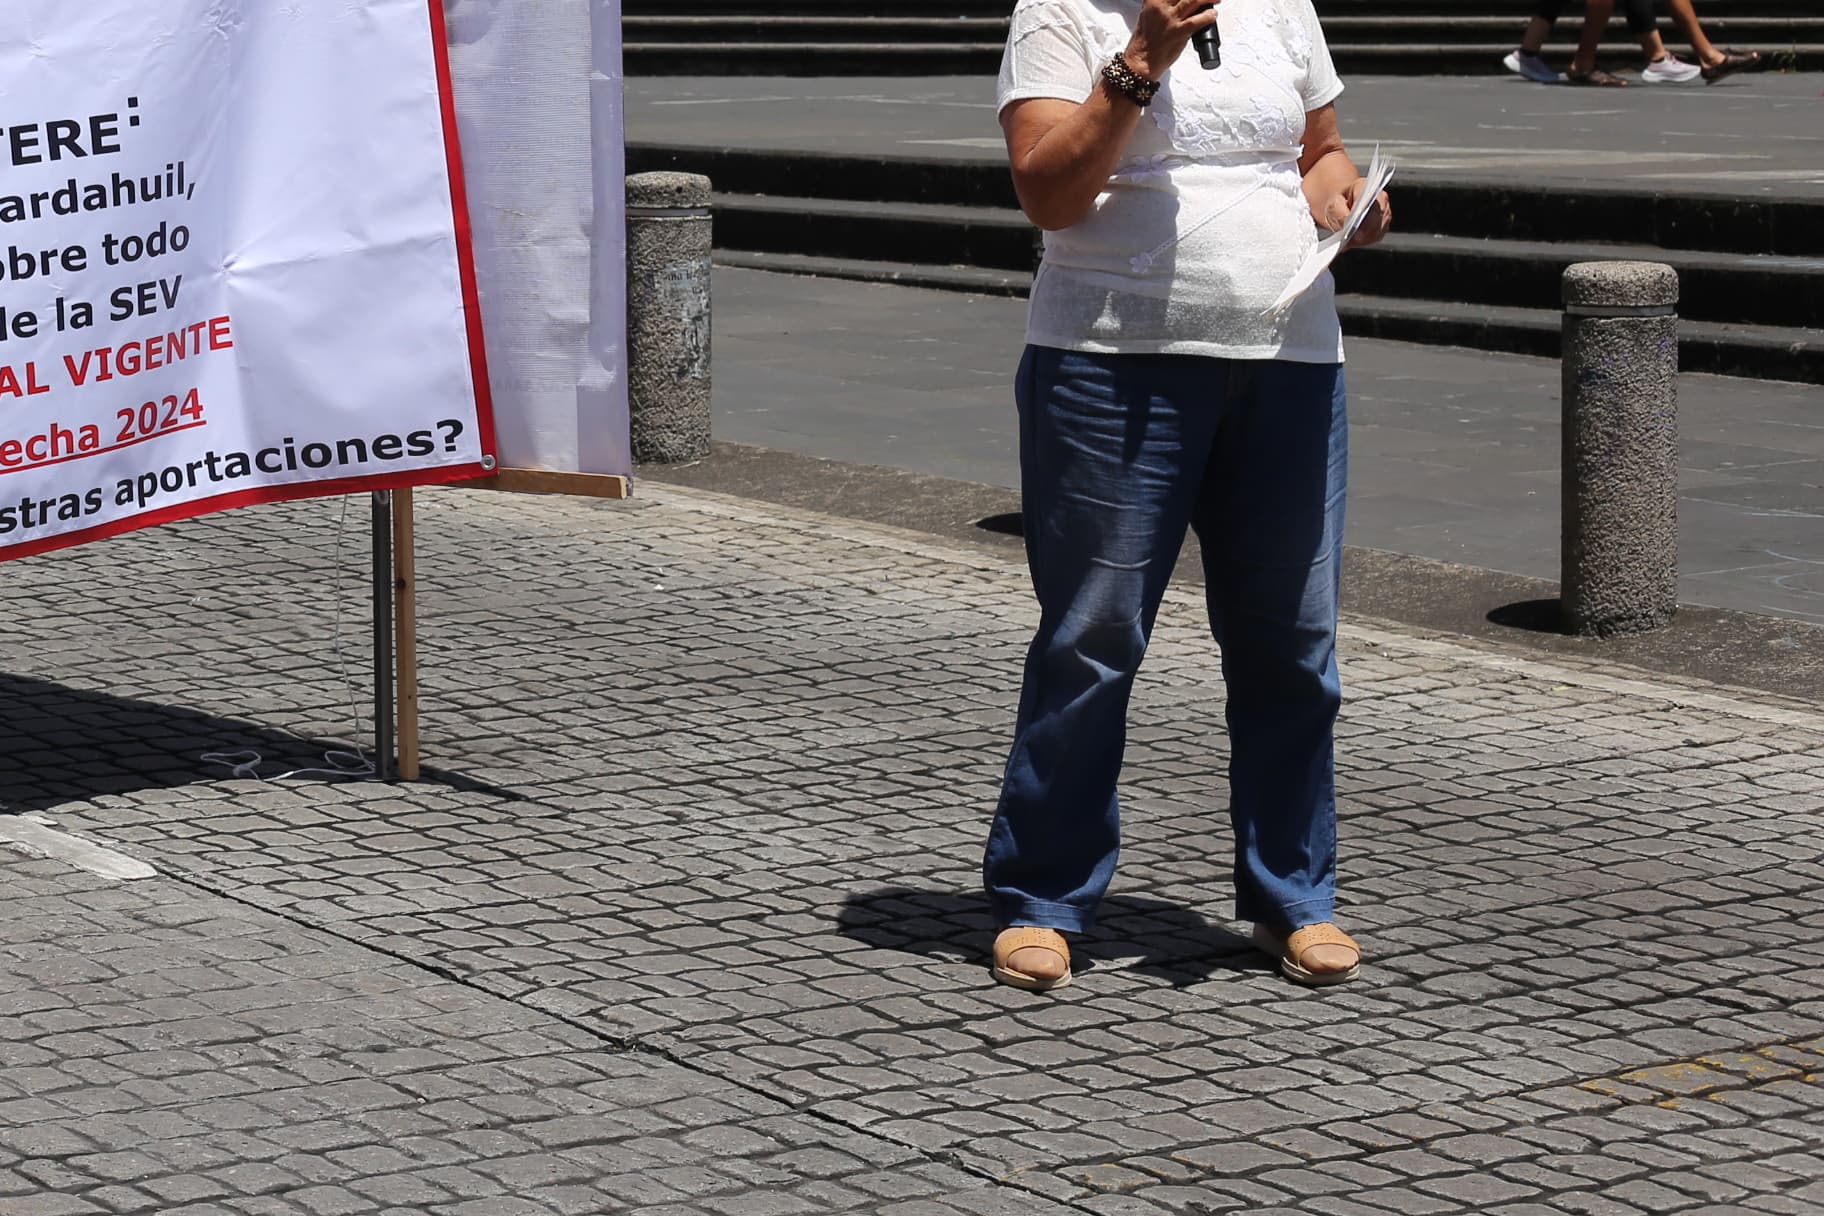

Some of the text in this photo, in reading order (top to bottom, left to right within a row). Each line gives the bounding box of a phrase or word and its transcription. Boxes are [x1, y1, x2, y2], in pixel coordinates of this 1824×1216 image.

[101, 220, 191, 264] todo
[55, 296, 95, 333] la
[109, 275, 184, 322] SEV
[63, 314, 235, 388] VIGENTE
[114, 387, 205, 446] 2024
[114, 419, 465, 507] aportaciones?
